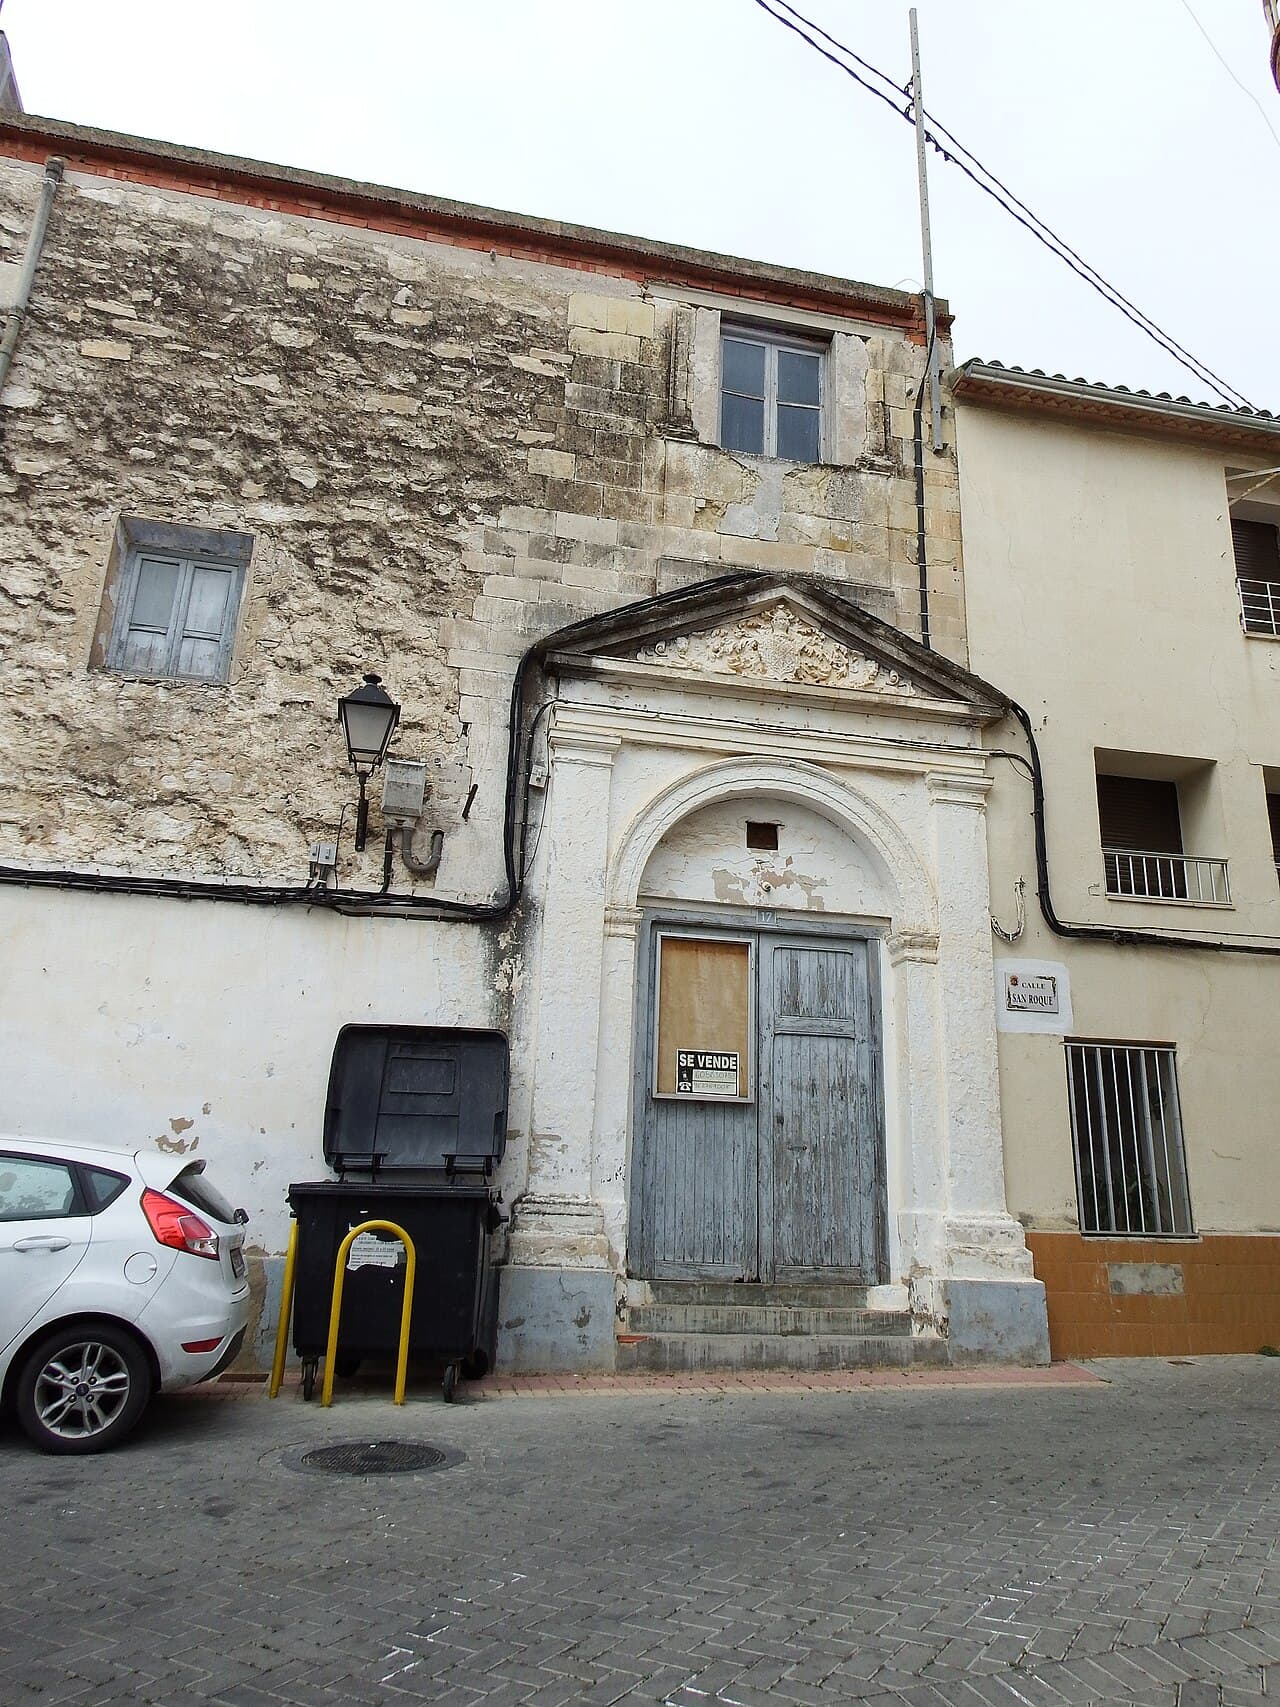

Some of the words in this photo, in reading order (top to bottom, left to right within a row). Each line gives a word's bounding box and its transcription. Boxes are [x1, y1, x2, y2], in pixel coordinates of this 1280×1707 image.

[760, 911, 772, 922] 17
[1021, 982, 1046, 990] CALLE
[1012, 993, 1027, 1003] SAN
[1028, 994, 1053, 1007] ROQUE
[679, 1053, 695, 1067] SE
[697, 1054, 737, 1070] VENDE
